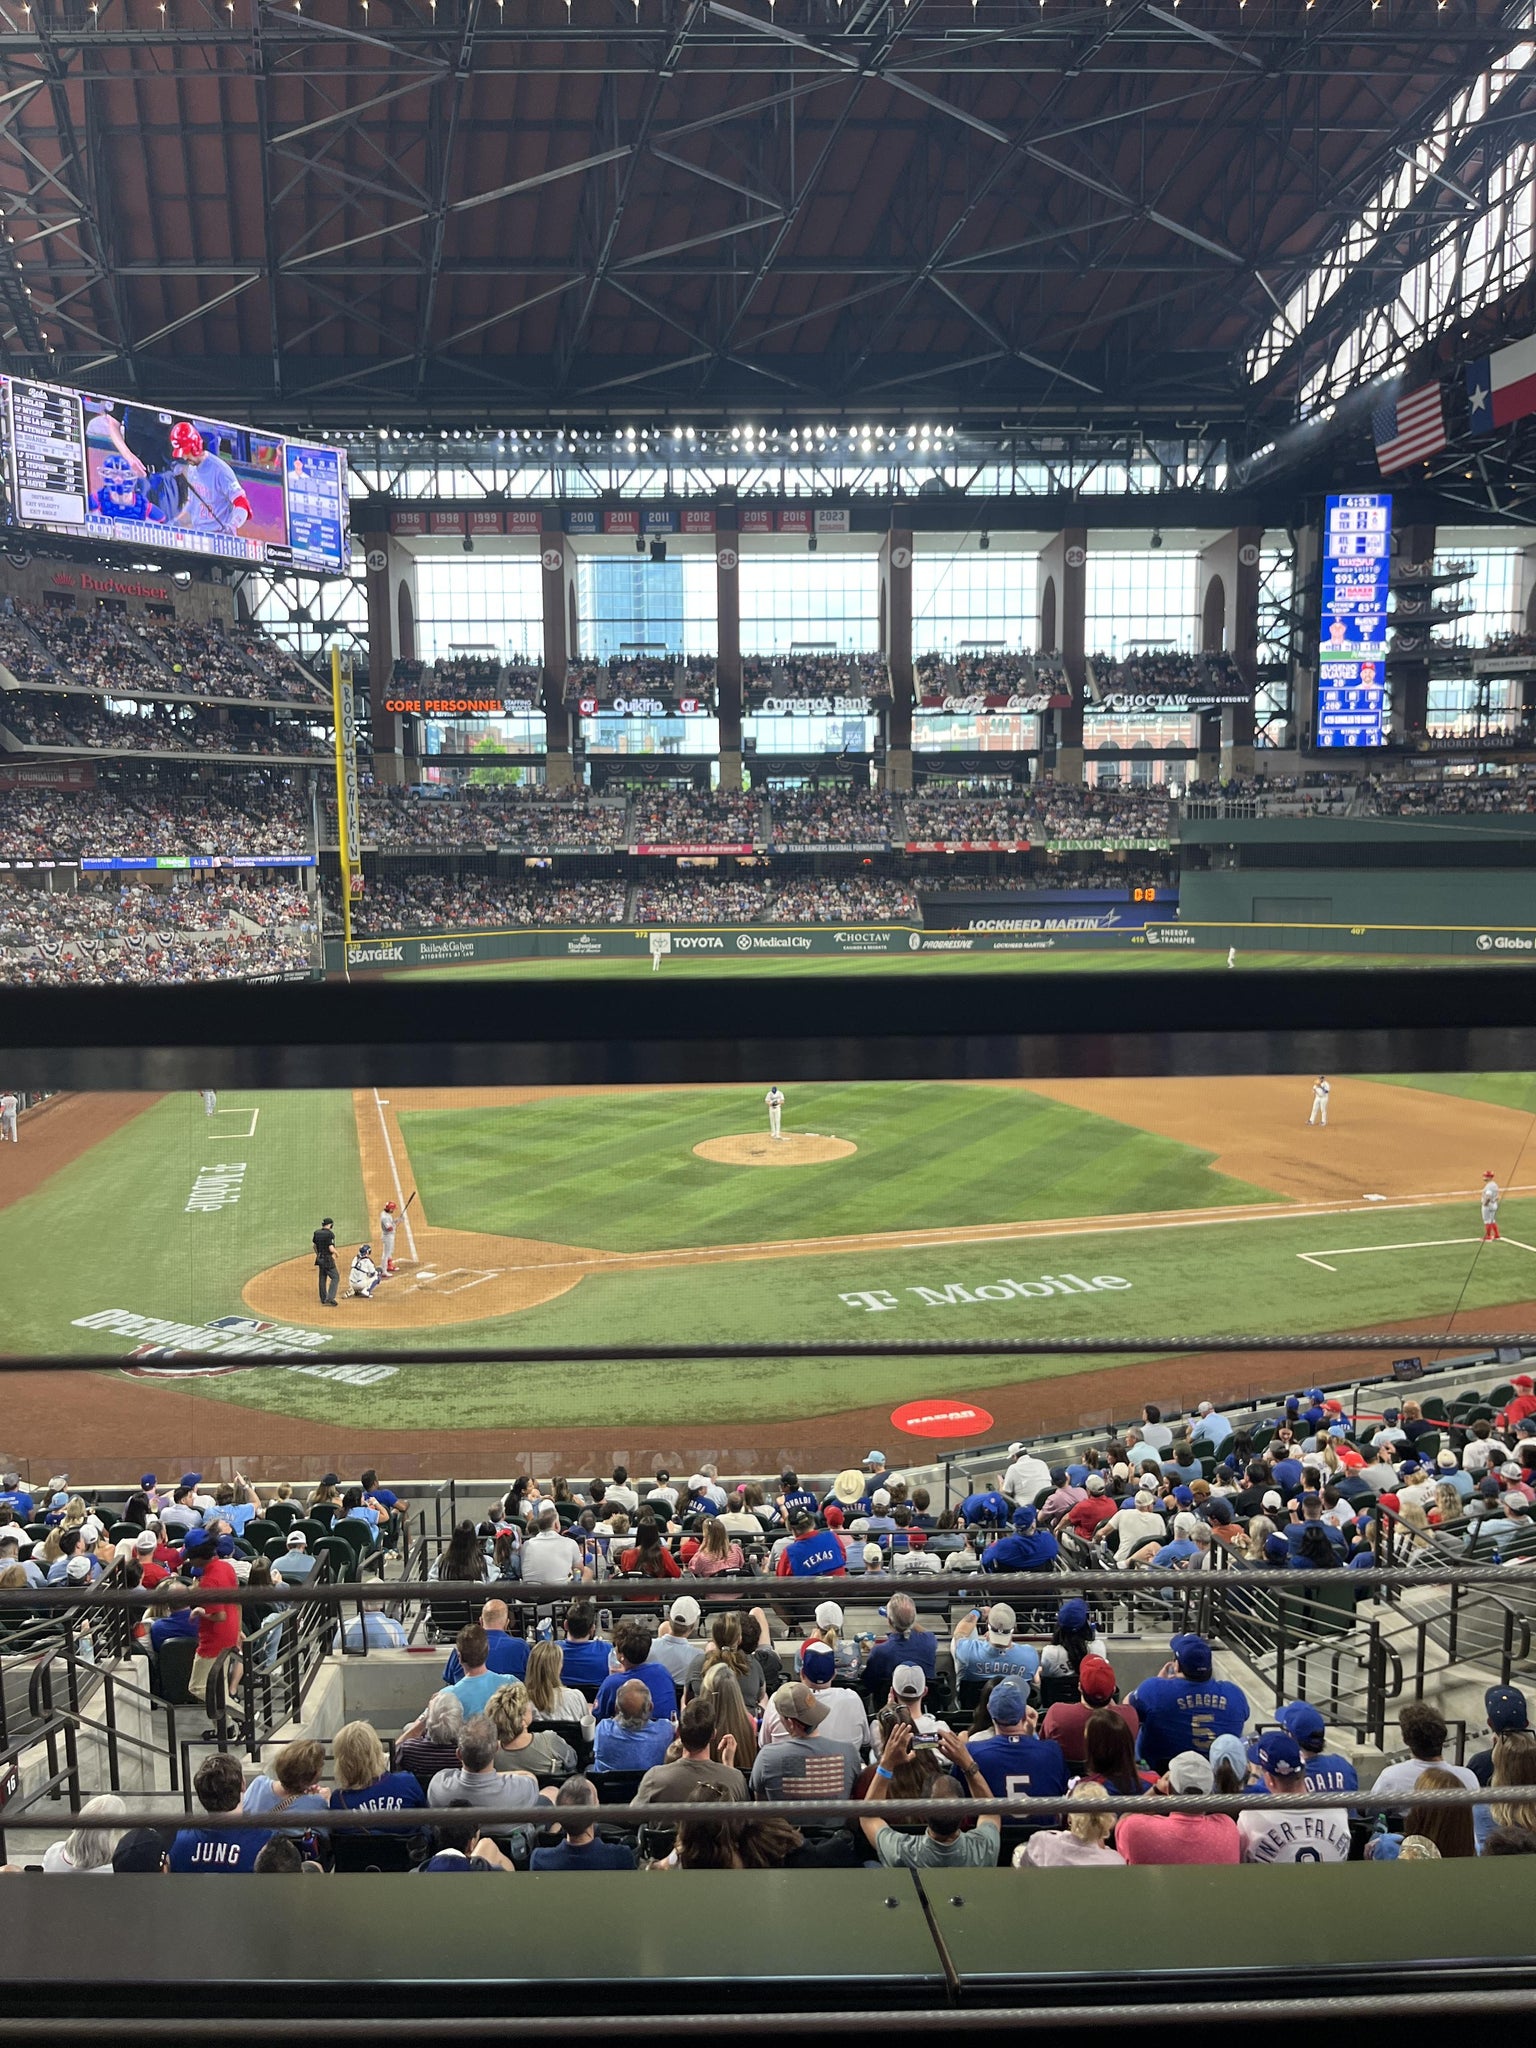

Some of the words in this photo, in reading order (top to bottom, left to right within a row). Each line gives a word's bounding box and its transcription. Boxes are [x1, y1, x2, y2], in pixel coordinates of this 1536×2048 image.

[397, 513, 420, 524] 1996
[437, 513, 459, 523] 1998
[474, 513, 497, 523] 1999
[513, 512, 536, 523] 2010
[571, 512, 594, 523] 2010
[610, 512, 632, 522] 2011
[648, 512, 669, 522] 2011
[687, 512, 710, 522] 2012
[744, 511, 767, 522] 2015
[783, 511, 806, 522] 2016
[819, 511, 844, 521] 2023
[369, 554, 384, 566] 42
[545, 555, 560, 566] 34
[720, 554, 735, 565] 26
[898, 552, 906, 564] 7
[1068, 551, 1083, 563] 29
[1242, 549, 1255, 561] 10
[386, 700, 420, 712] CORE
[424, 700, 504, 711] PERSONNEL
[613, 699, 663, 713] QuikTrip
[834, 696, 872, 710] Bank
[1112, 694, 1188, 706] CHOCTAW
[580, 701, 595, 712] QT
[1430, 738, 1480, 750] PRIORITY
[1483, 737, 1514, 748] GOLD
[346, 774, 358, 858] CHIKIN
[1058, 841, 1100, 850] LUXOR
[1104, 840, 1167, 849] STAFFING
[969, 919, 1048, 930] LOCKHEED
[1051, 919, 1099, 929] MARTIN
[674, 937, 723, 948] TOYOTA
[753, 937, 790, 948] Medical
[792, 937, 812, 949] City
[840, 932, 890, 942] CHOCTAW
[1160, 936, 1195, 944] TRANSFER
[922, 940, 974, 949] PROGRESSIVE
[1495, 937, 1532, 950] Globe
[348, 946, 404, 964] SEATGEEK
[906, 1274, 1133, 1306] Mobile
[71, 1308, 236, 1350] OPENING
[803, 1550, 833, 1568] TEXAS
[976, 1662, 1026, 1678] SEAGER
[1176, 1696, 1227, 1711] SEAGER
[7, 1774, 16, 1795] 16
[1005, 1774, 1032, 1818] 5
[191, 1843, 241, 1864] JUNG
